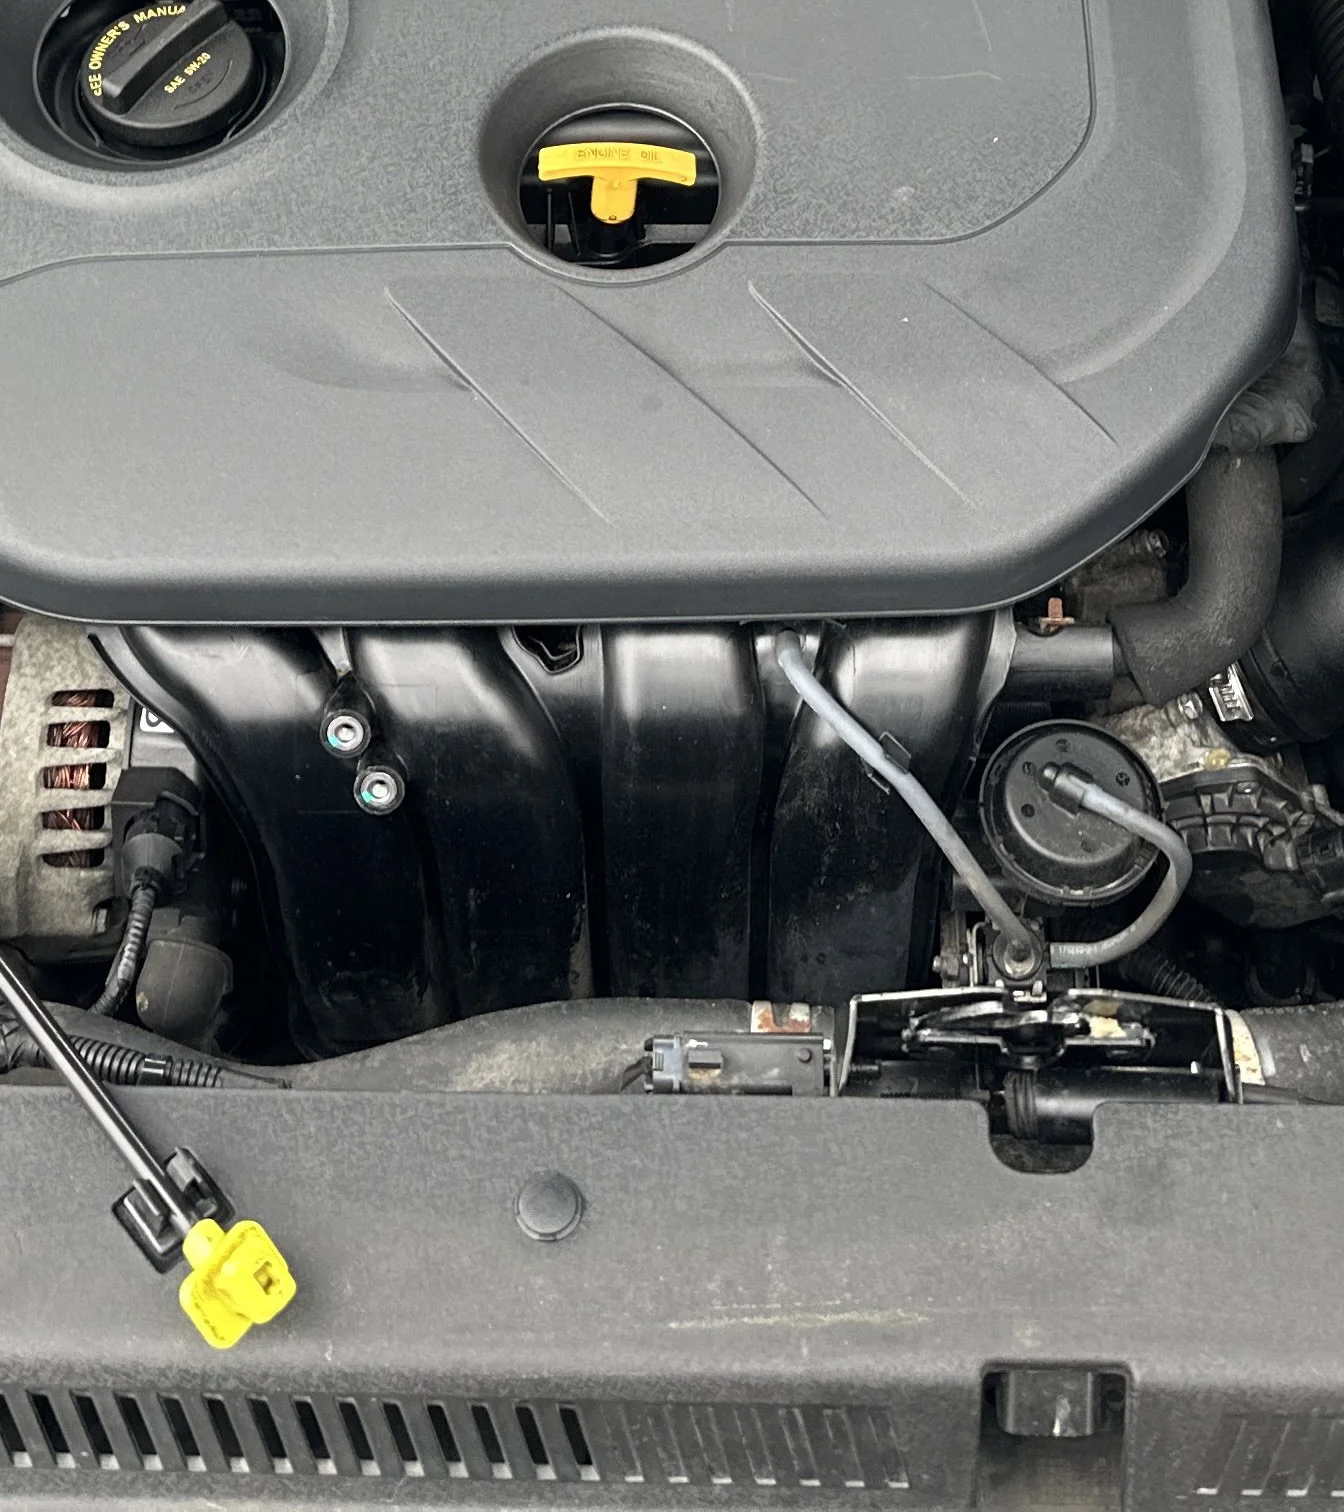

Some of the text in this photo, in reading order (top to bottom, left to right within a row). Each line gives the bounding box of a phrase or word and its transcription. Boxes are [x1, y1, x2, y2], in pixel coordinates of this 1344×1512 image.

[88, 20, 131, 71] OWNER'S
[133, 5, 187, 24] MANUA
[164, 52, 212, 94] SAE 5W-20
[577, 148, 663, 164] ENGINE OIL
